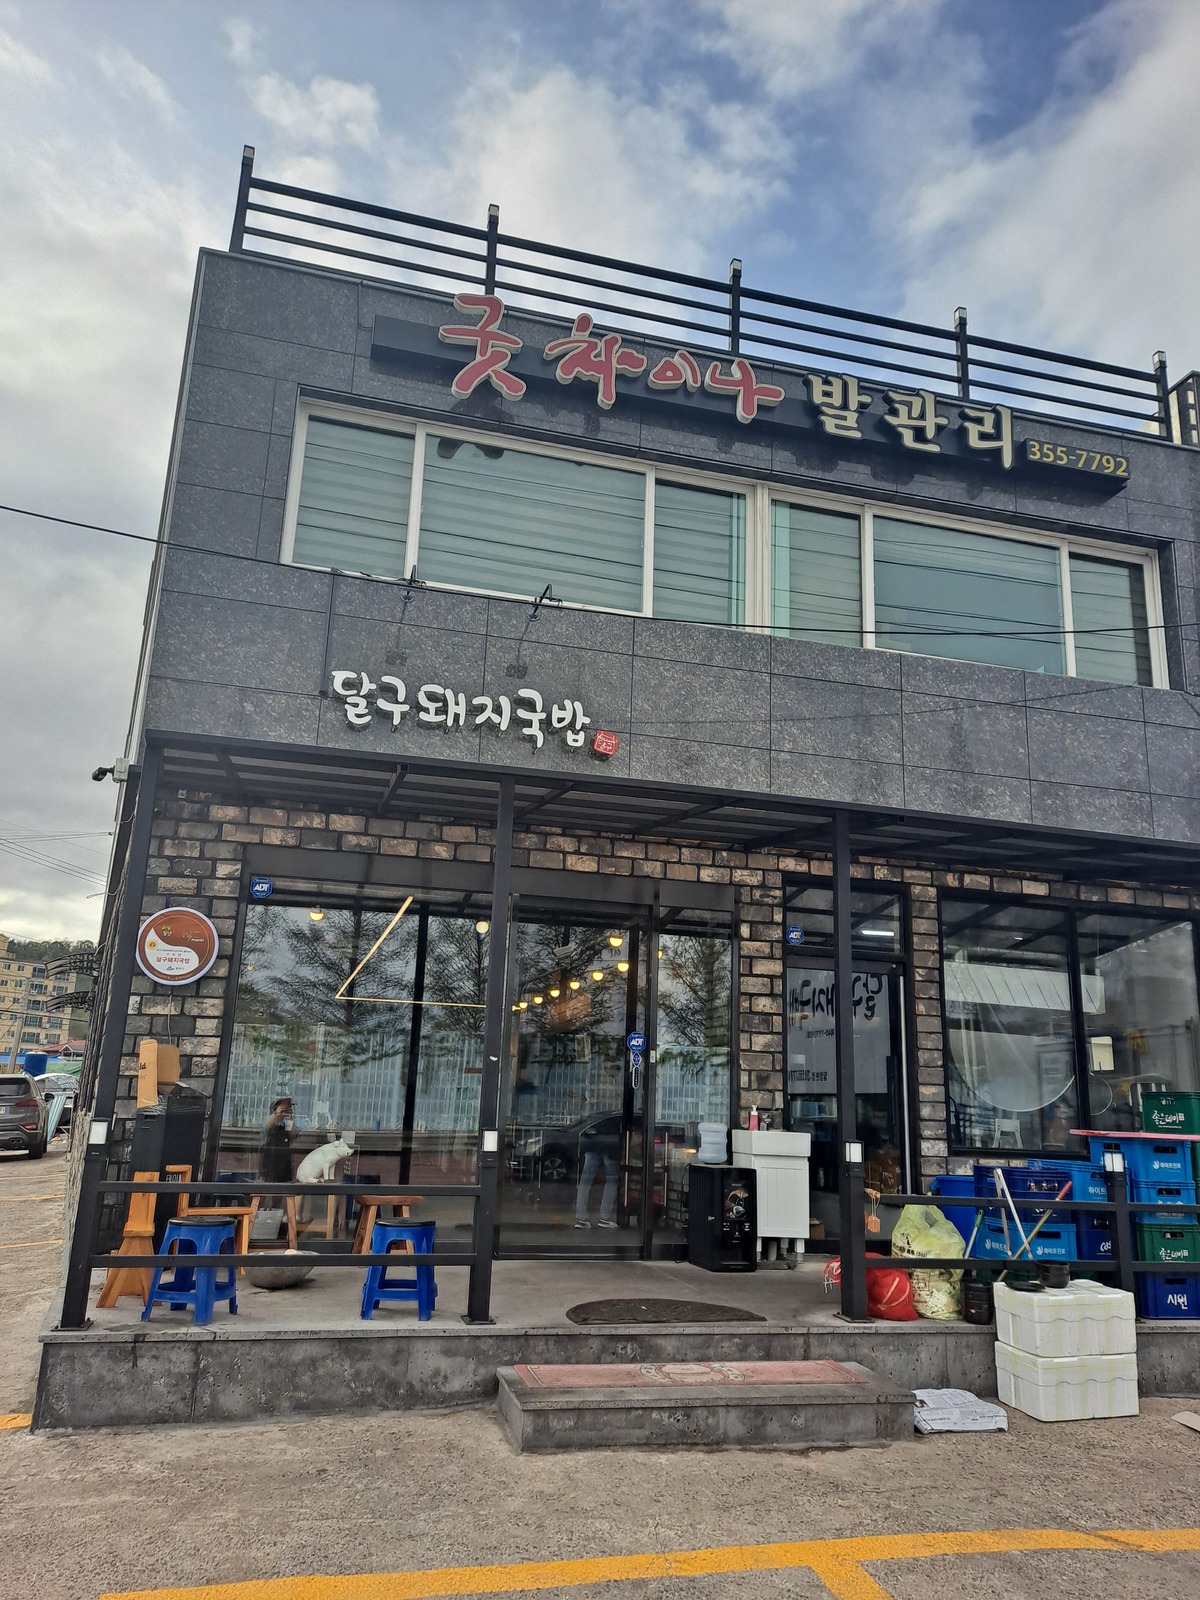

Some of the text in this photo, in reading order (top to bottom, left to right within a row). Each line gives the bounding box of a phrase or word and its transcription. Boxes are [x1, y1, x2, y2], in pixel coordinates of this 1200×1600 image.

[437, 292, 1129, 478] 굿 차이나 발관리 355-7792
[331, 669, 591, 749] 달구돼지국밥
[253, 883, 269, 892] ADT
[788, 931, 802, 939] ADT
[156, 956, 190, 965] 달구돼지국밥
[629, 1037, 644, 1047] ADT
[1152, 1109, 1179, 1125] 좋은데이
[1160, 1161, 1182, 1169] 하이트진로
[991, 1241, 1009, 1252] 하이트진
[1043, 1247, 1066, 1255] 하이트진로
[1159, 1247, 1183, 1261] 좋은데이
[1167, 1293, 1188, 1310] 시원
